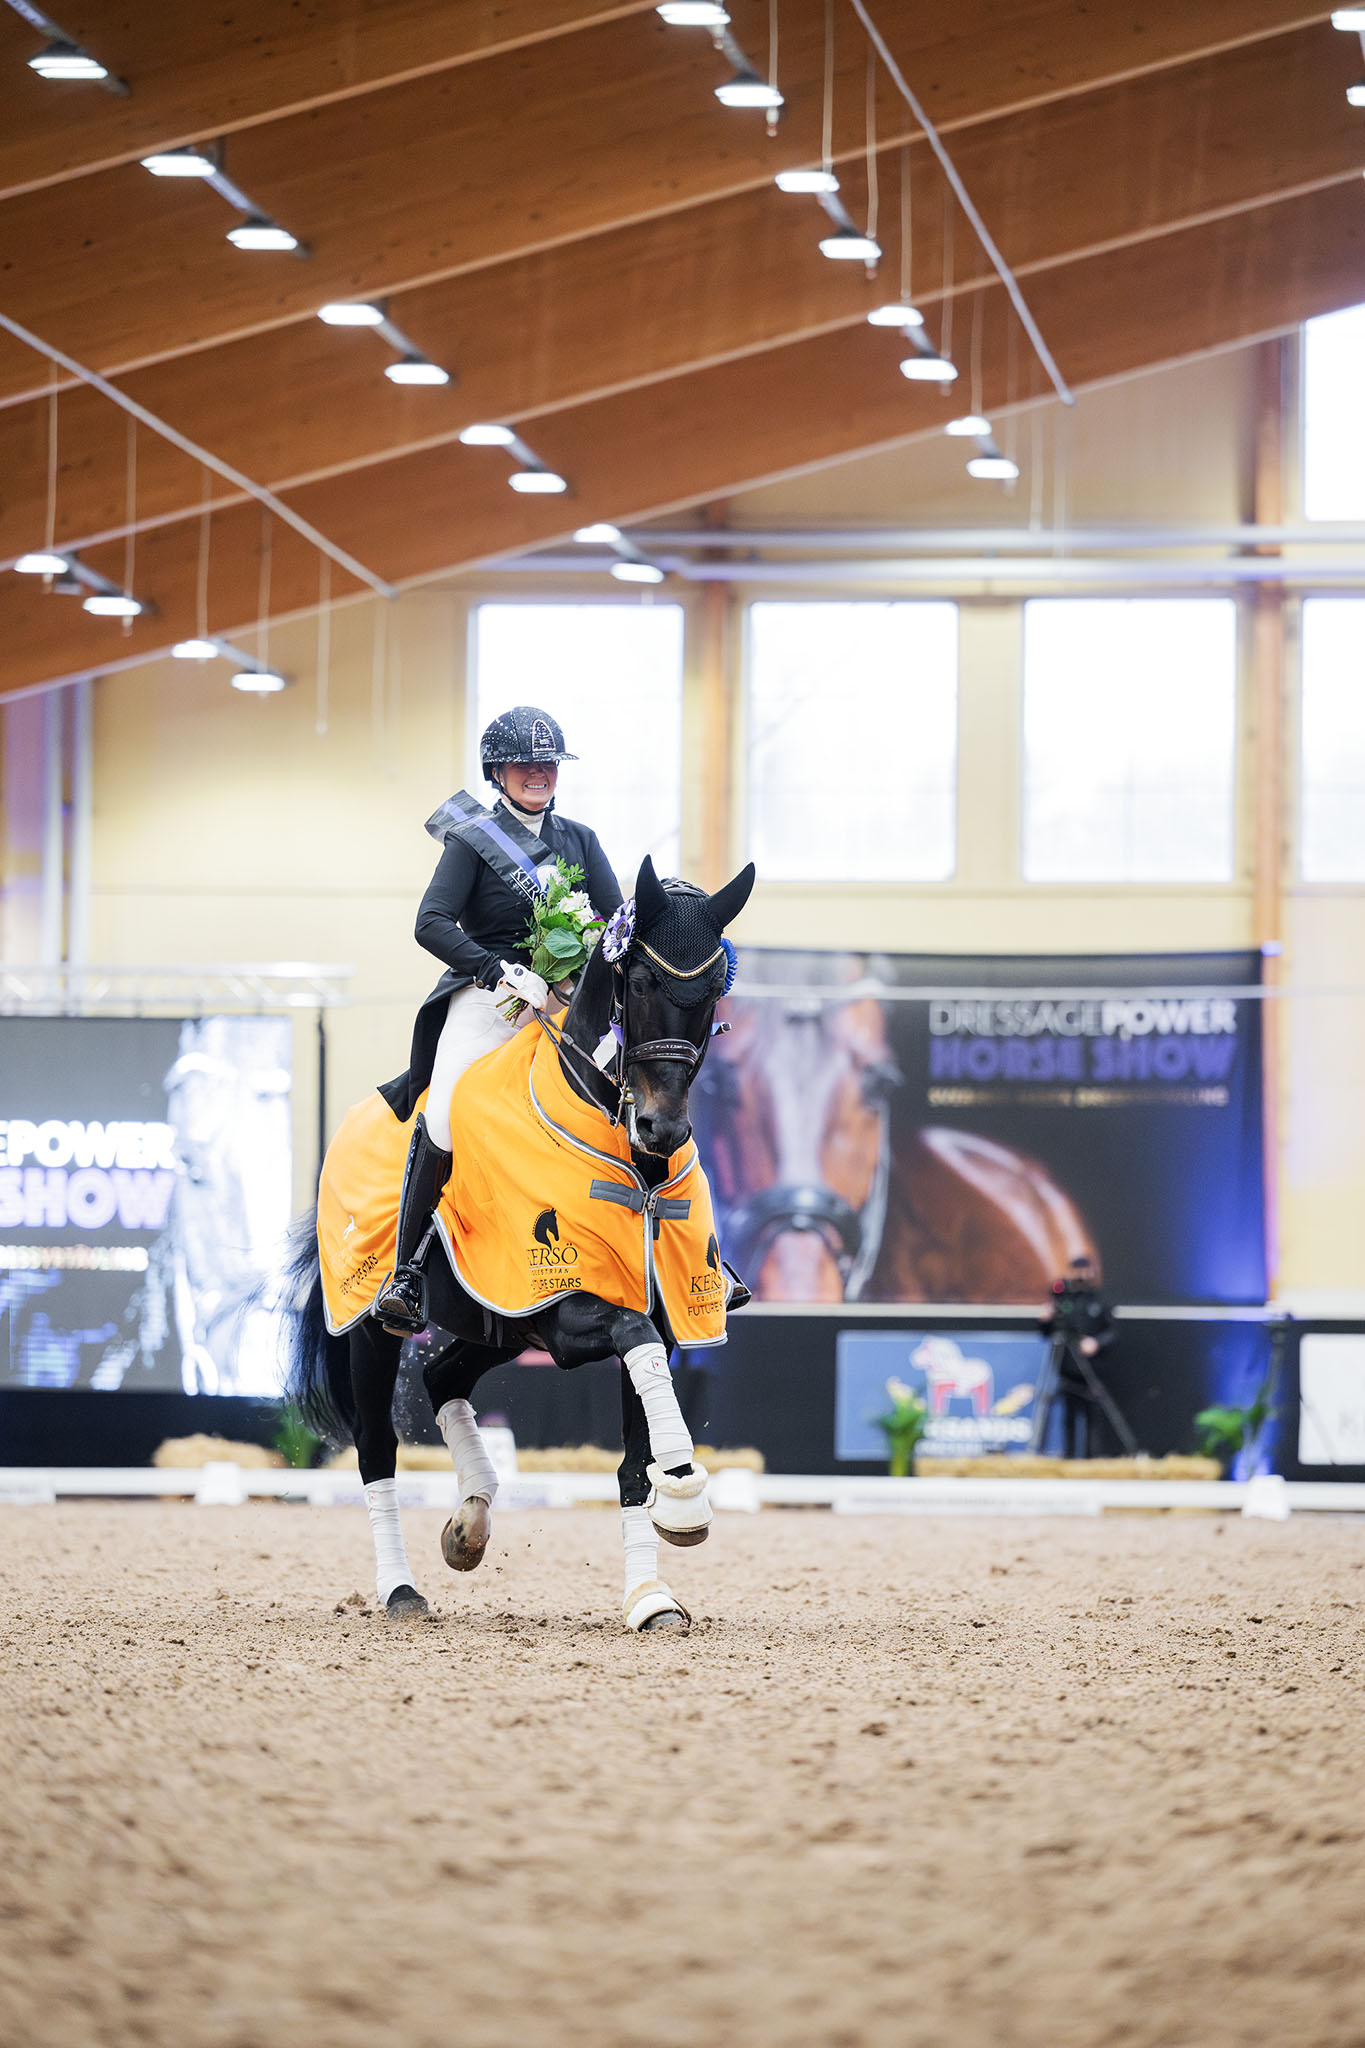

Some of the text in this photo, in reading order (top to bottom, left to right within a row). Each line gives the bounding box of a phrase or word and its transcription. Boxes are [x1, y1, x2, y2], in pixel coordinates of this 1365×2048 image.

[513, 866, 549, 904] KERS
[929, 1037, 1237, 1081] HORSE SHOW
